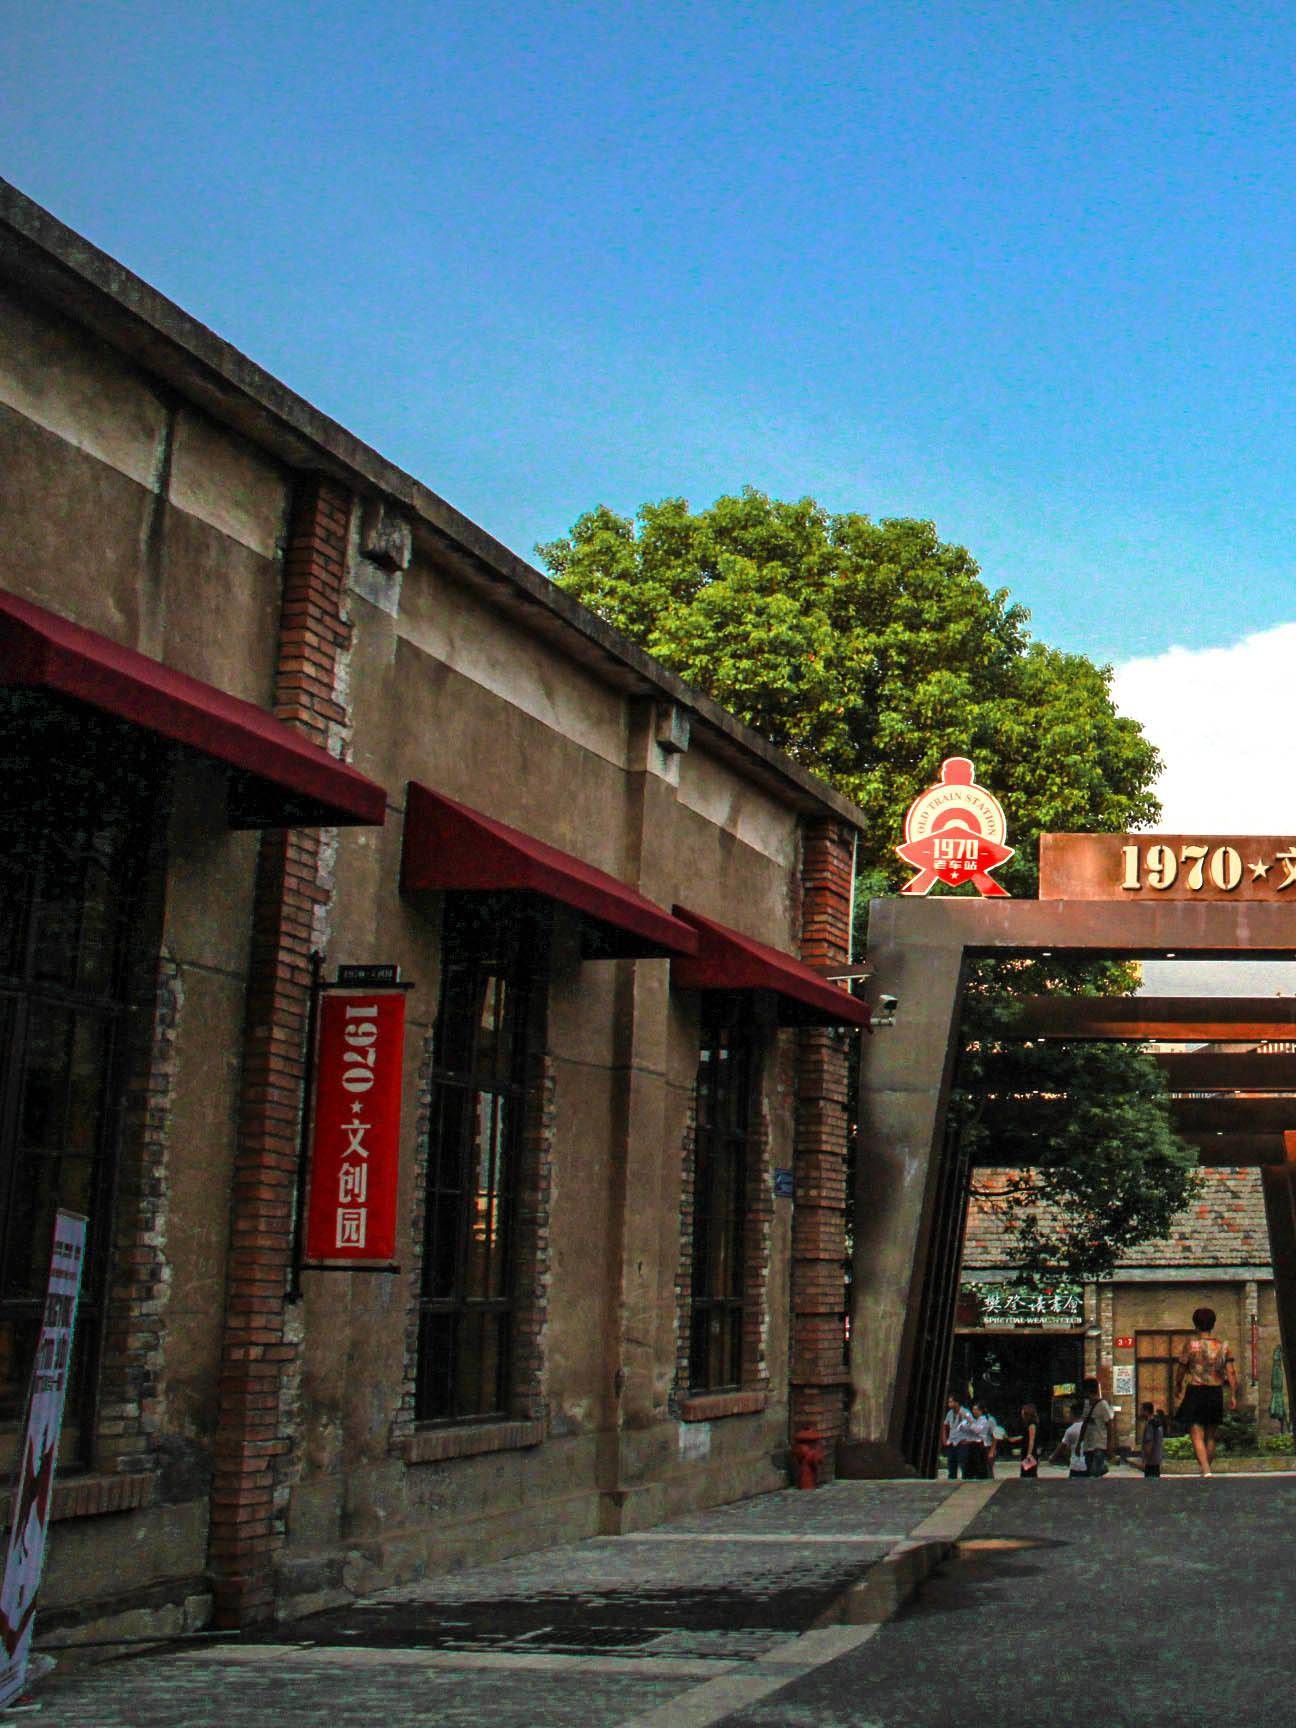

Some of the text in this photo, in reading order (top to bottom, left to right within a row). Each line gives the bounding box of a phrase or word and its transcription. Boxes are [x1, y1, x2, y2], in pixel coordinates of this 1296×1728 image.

[918, 792, 996, 836] OLD TRAIN STATION
[933, 838, 979, 860] 1970
[933, 860, 978, 871] 老车站
[1120, 845, 1244, 891] 1970
[335, 1004, 379, 1249] 1970 文创园
